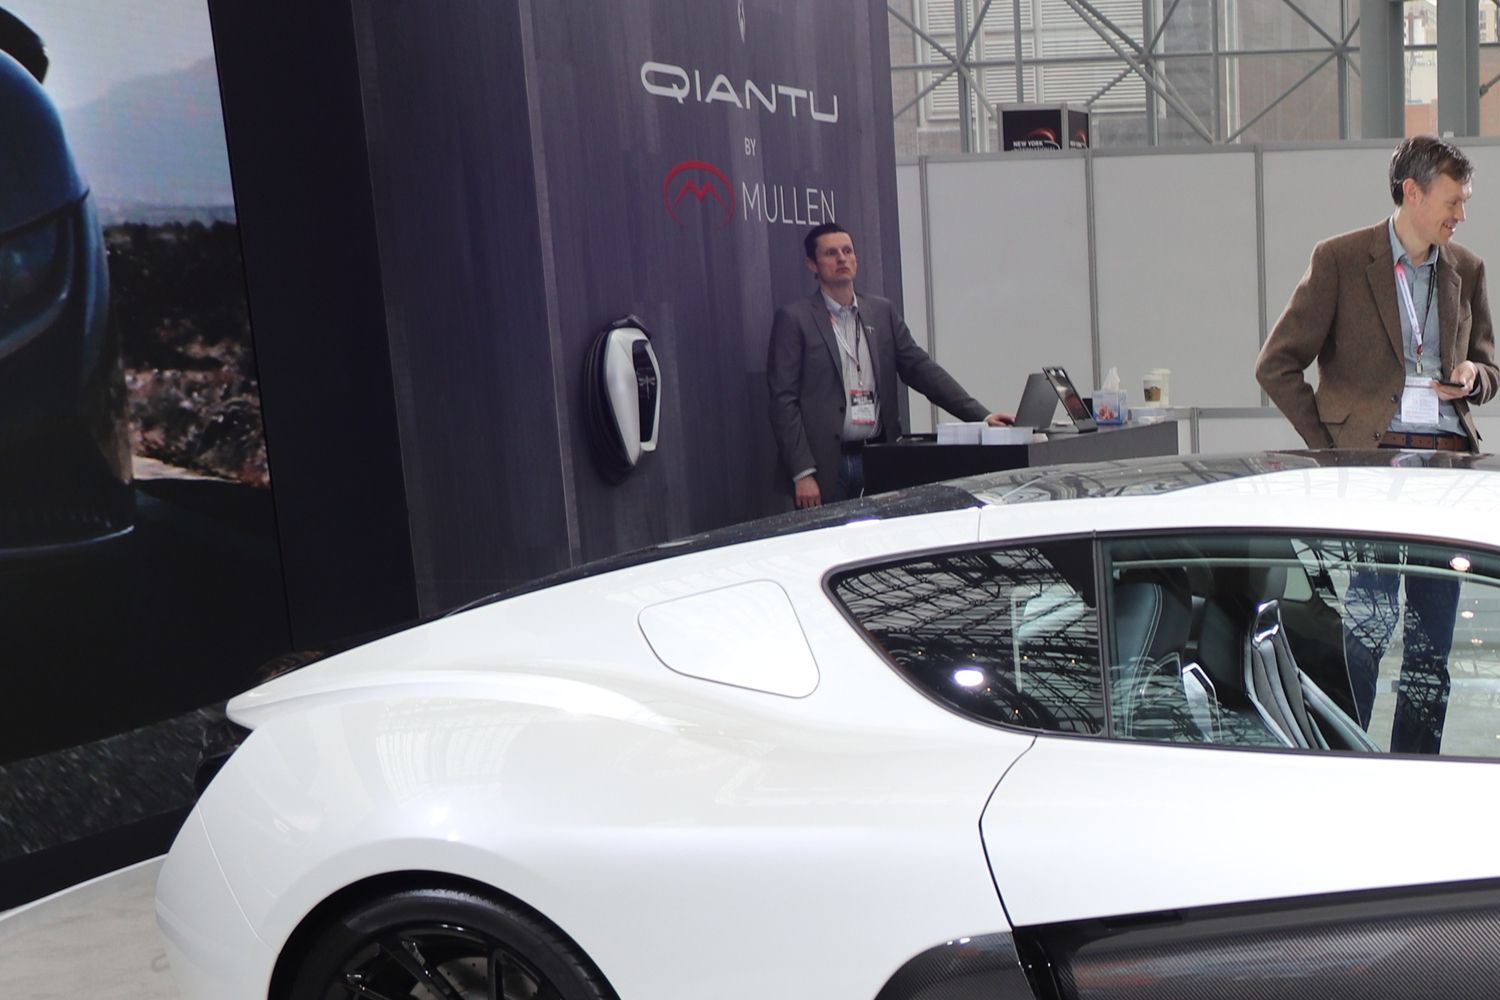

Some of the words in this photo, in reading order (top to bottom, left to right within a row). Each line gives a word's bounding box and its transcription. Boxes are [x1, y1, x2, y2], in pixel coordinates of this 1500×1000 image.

[641, 61, 838, 123] QIANTU
[744, 137, 756, 156] BY
[1013, 140, 1027, 148] NEW
[1027, 140, 1044, 148] YORK
[742, 181, 836, 226] MULLEN
